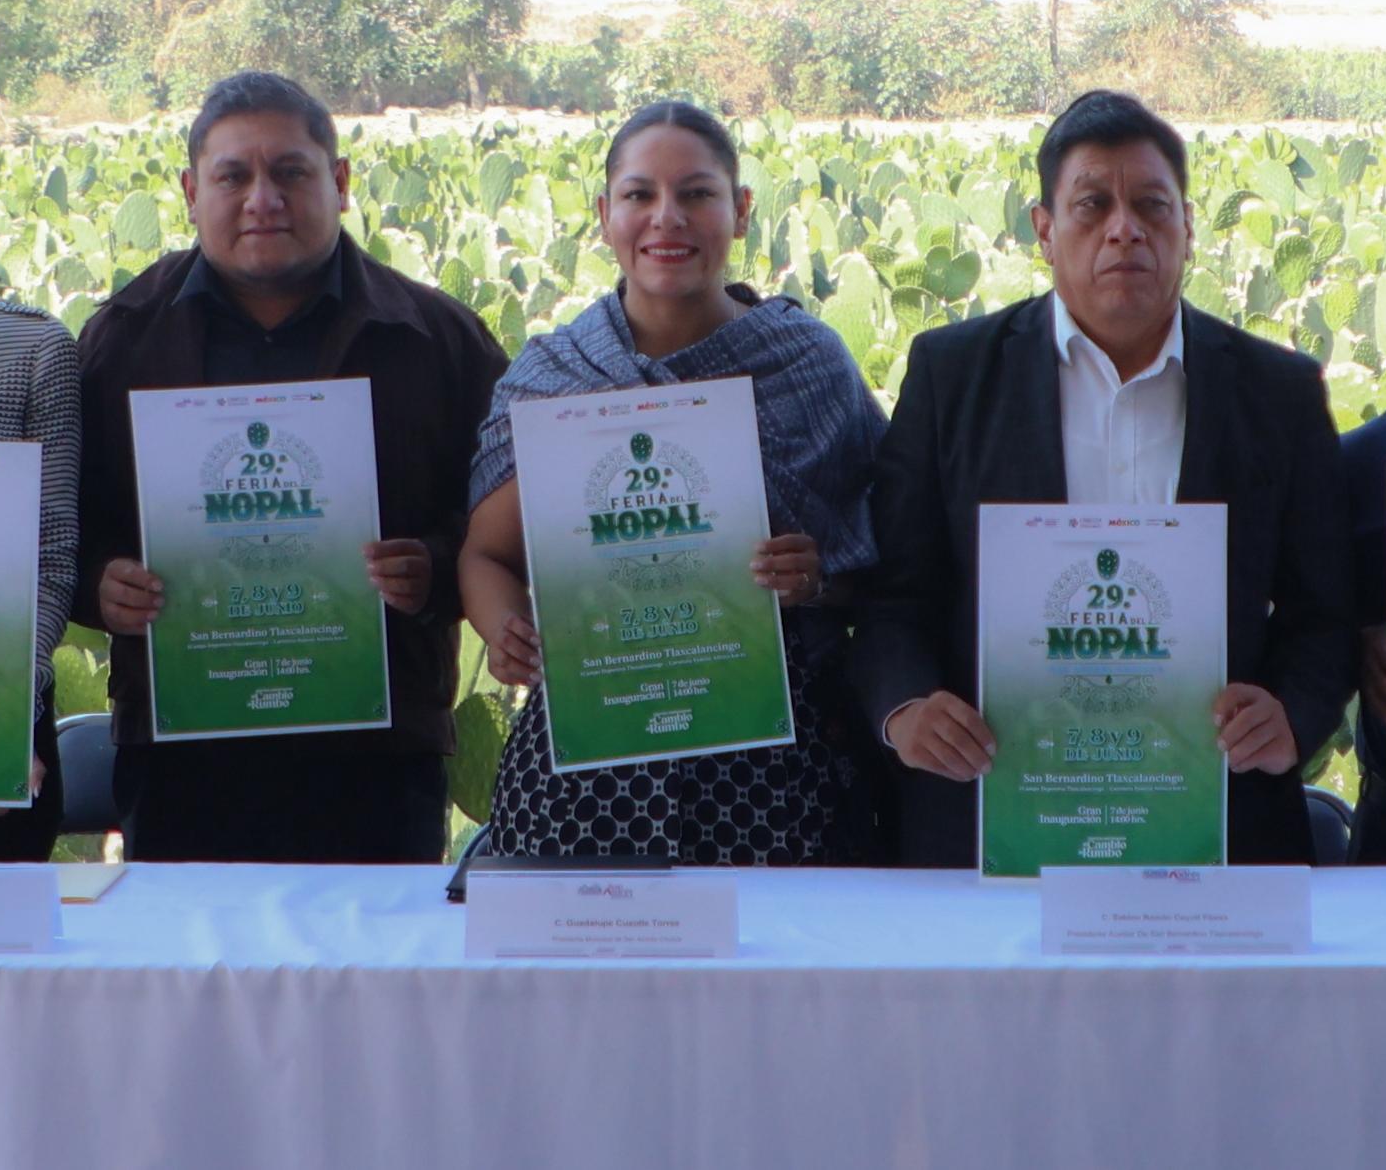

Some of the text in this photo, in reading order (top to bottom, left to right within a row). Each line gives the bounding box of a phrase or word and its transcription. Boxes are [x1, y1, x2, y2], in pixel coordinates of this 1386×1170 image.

[226, 476, 280, 491] FERIA
[202, 488, 324, 523] NOPAL
[610, 491, 667, 510] FERIA
[587, 500, 713, 545] NOPAL
[250, 584, 266, 602] 8
[268, 585, 285, 602] y
[286, 582, 303, 600] 9
[227, 599, 305, 618] DE JUNIO
[642, 605, 659, 624] 8
[660, 605, 678, 623] y
[678, 600, 696, 620] 9
[1070, 612, 1127, 624] FERIA
[188, 623, 345, 640] San Bernardino Tlaxcalancingo
[619, 618, 699, 642] DE JUNIO
[1045, 626, 1171, 659] NOPAL
[582, 656, 602, 667] San
[604, 649, 662, 665] Bernardino
[663, 640, 741, 660] Tlaxcalancingo
[243, 658, 267, 668] Gran
[638, 681, 663, 692] Gran
[649, 719, 689, 734] Rumbo
[1089, 728, 1105, 746] 8
[1108, 730, 1124, 747] y
[1126, 727, 1143, 745] 9
[1064, 745, 1144, 761] DE JUNIO
[1023, 773, 1183, 784] San Bernardino Tlaxcalancingo
[1077, 805, 1101, 814] Gran
[1082, 848, 1122, 858] Rumbo
